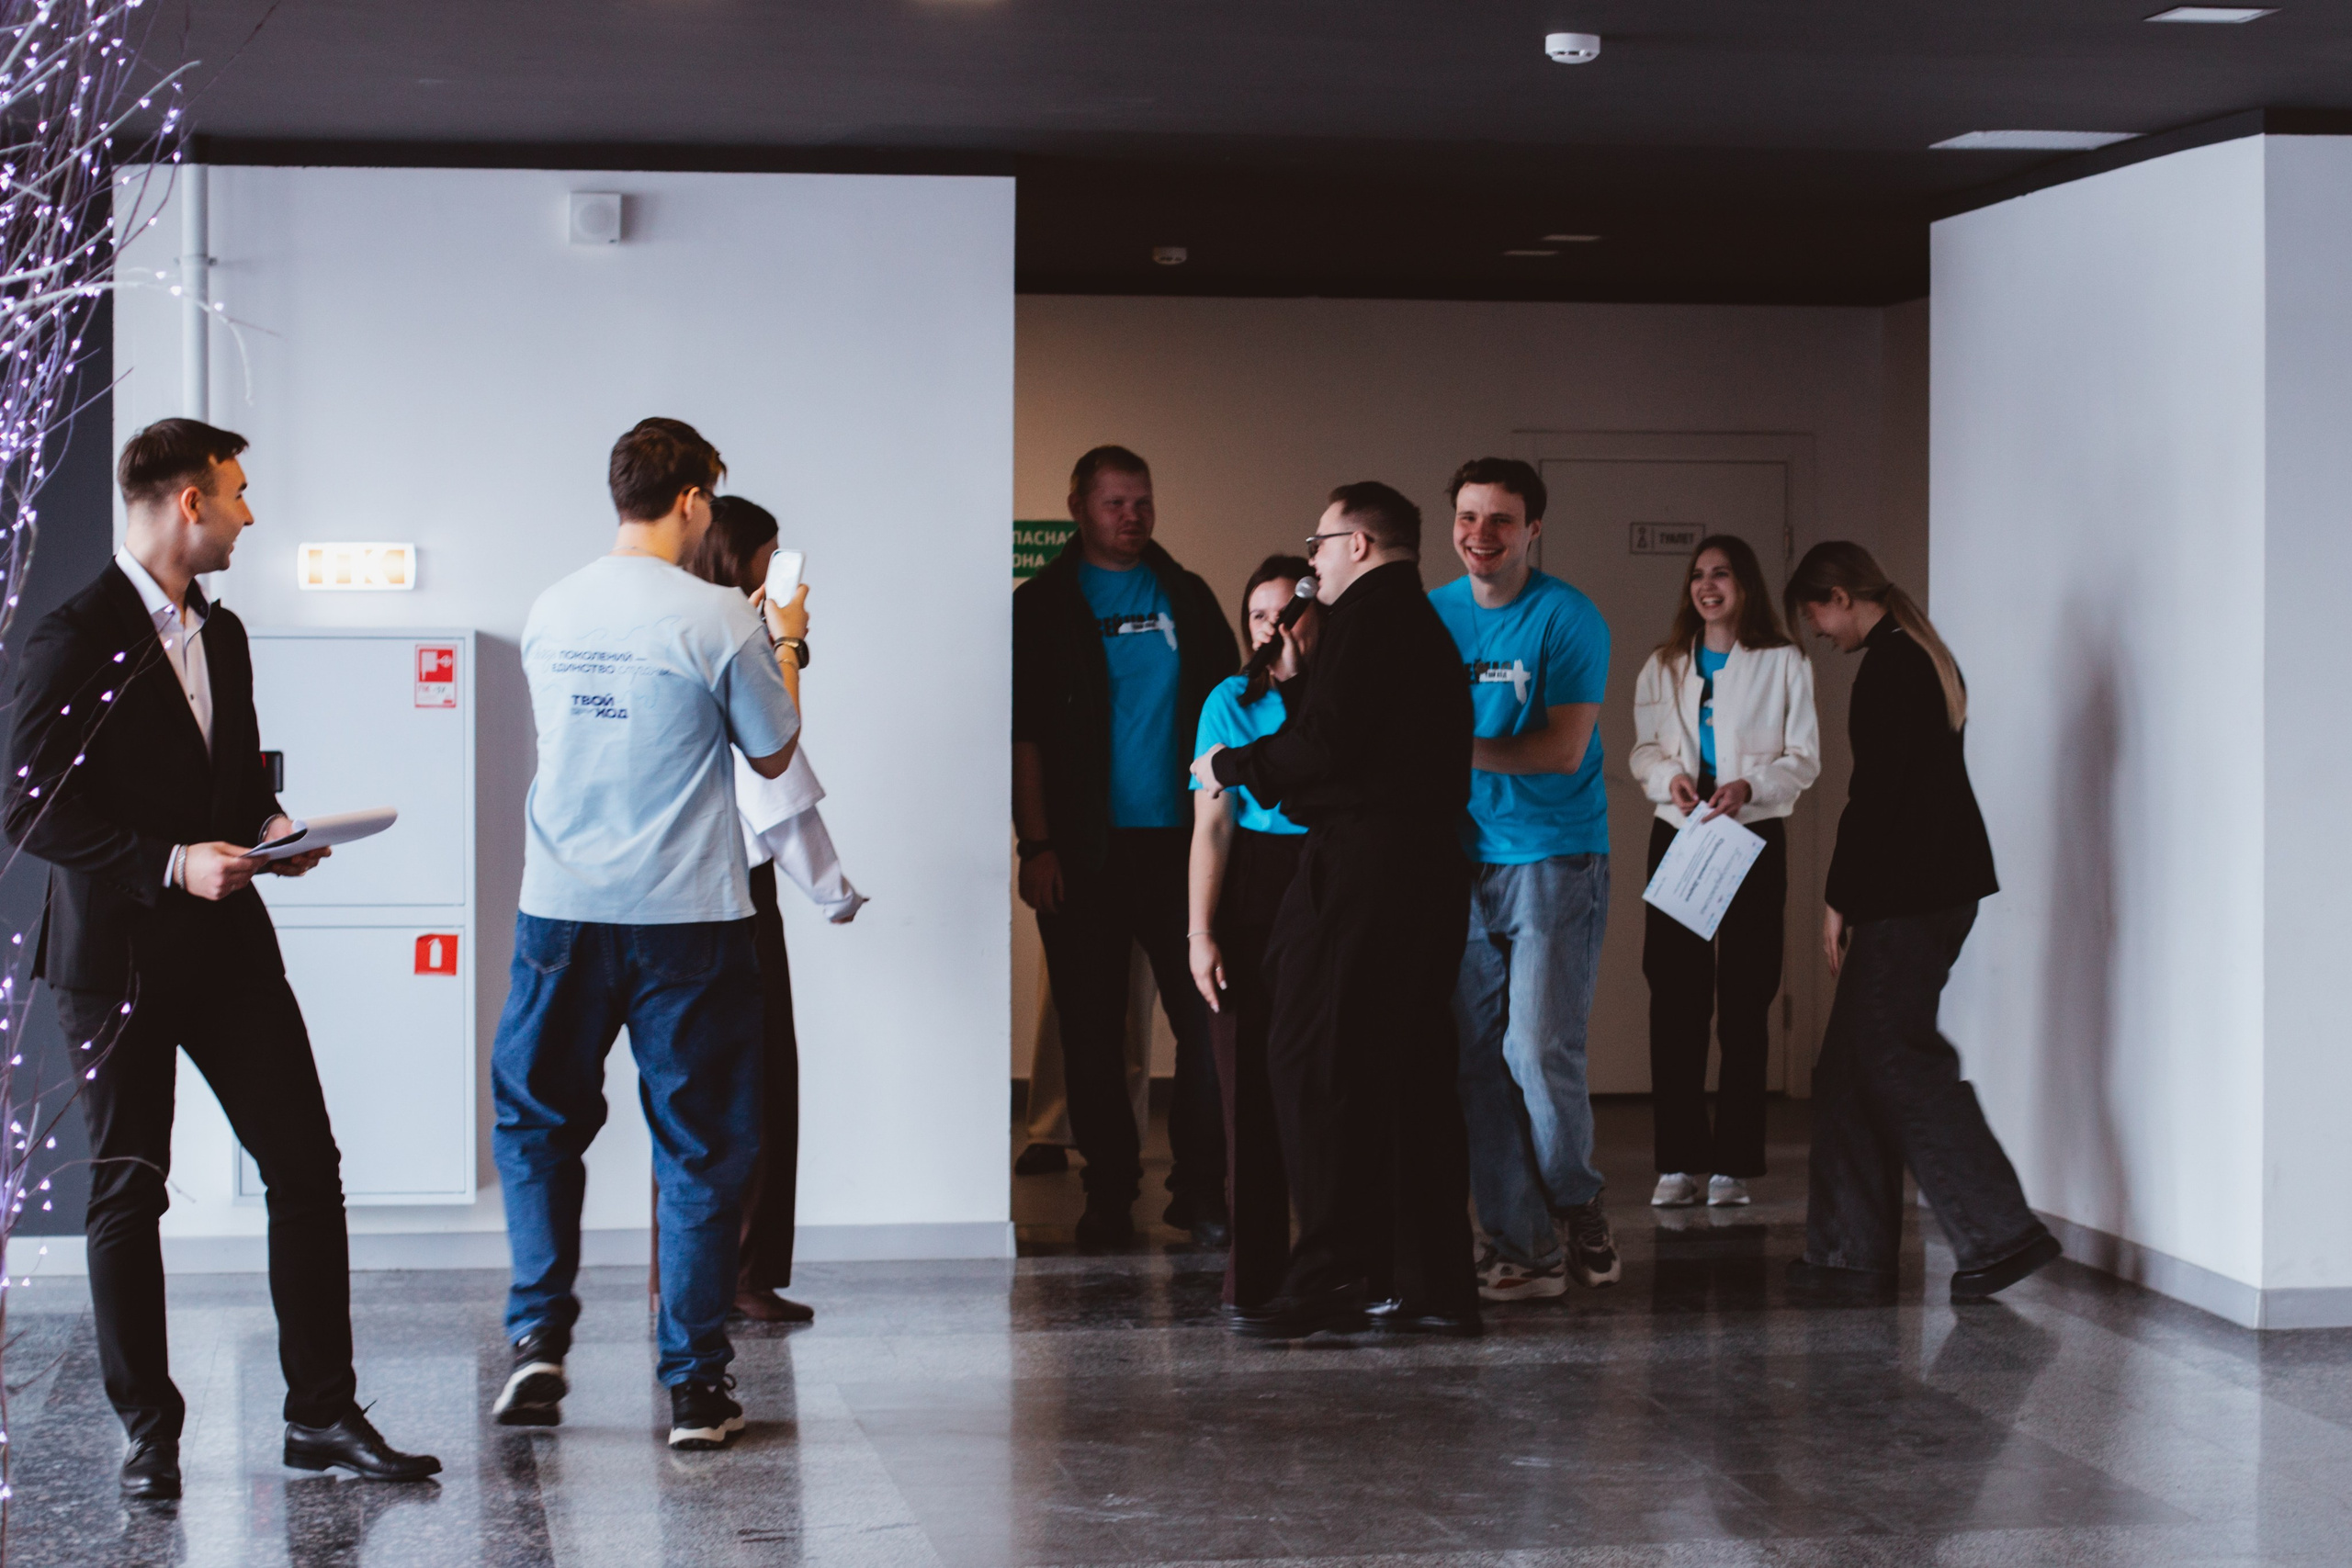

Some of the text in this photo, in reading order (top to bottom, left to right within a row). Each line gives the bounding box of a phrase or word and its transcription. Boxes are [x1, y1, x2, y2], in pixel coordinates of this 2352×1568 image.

[1013, 530, 1074, 546] ПАСНА
[559, 649, 633, 662] ПОКОЛЕНИЙ
[551, 662, 616, 675] ЕДИНСТВО
[571, 693, 615, 706] ТВОЙ
